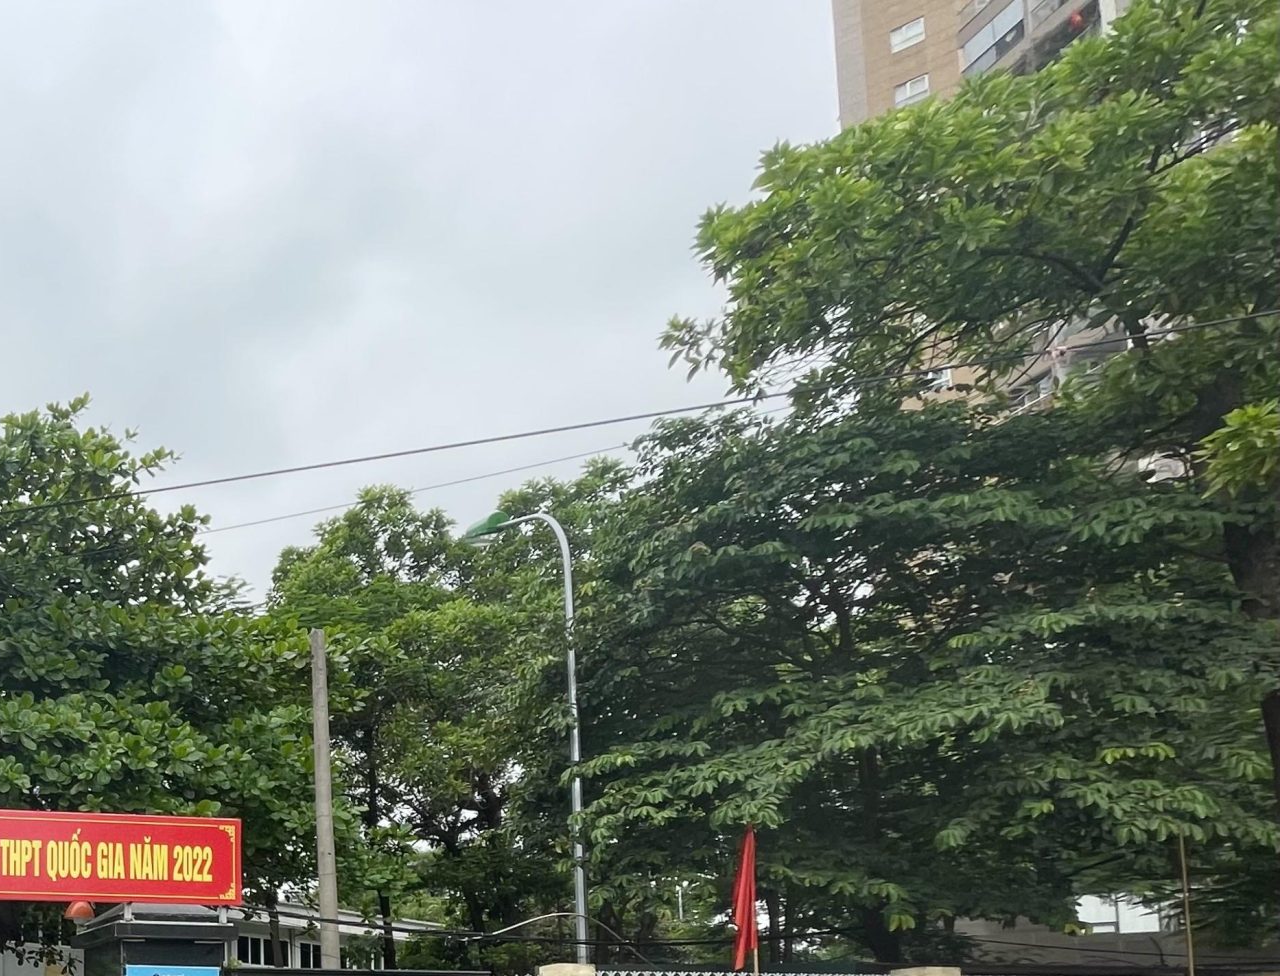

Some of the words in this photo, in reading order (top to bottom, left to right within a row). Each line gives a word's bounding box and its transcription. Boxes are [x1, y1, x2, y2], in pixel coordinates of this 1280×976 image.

[0, 838, 42, 877] THPT
[46, 828, 91, 881] QUỐC
[97, 842, 125, 880] GIA
[129, 836, 169, 881] NĂM
[173, 845, 212, 882] 2022
